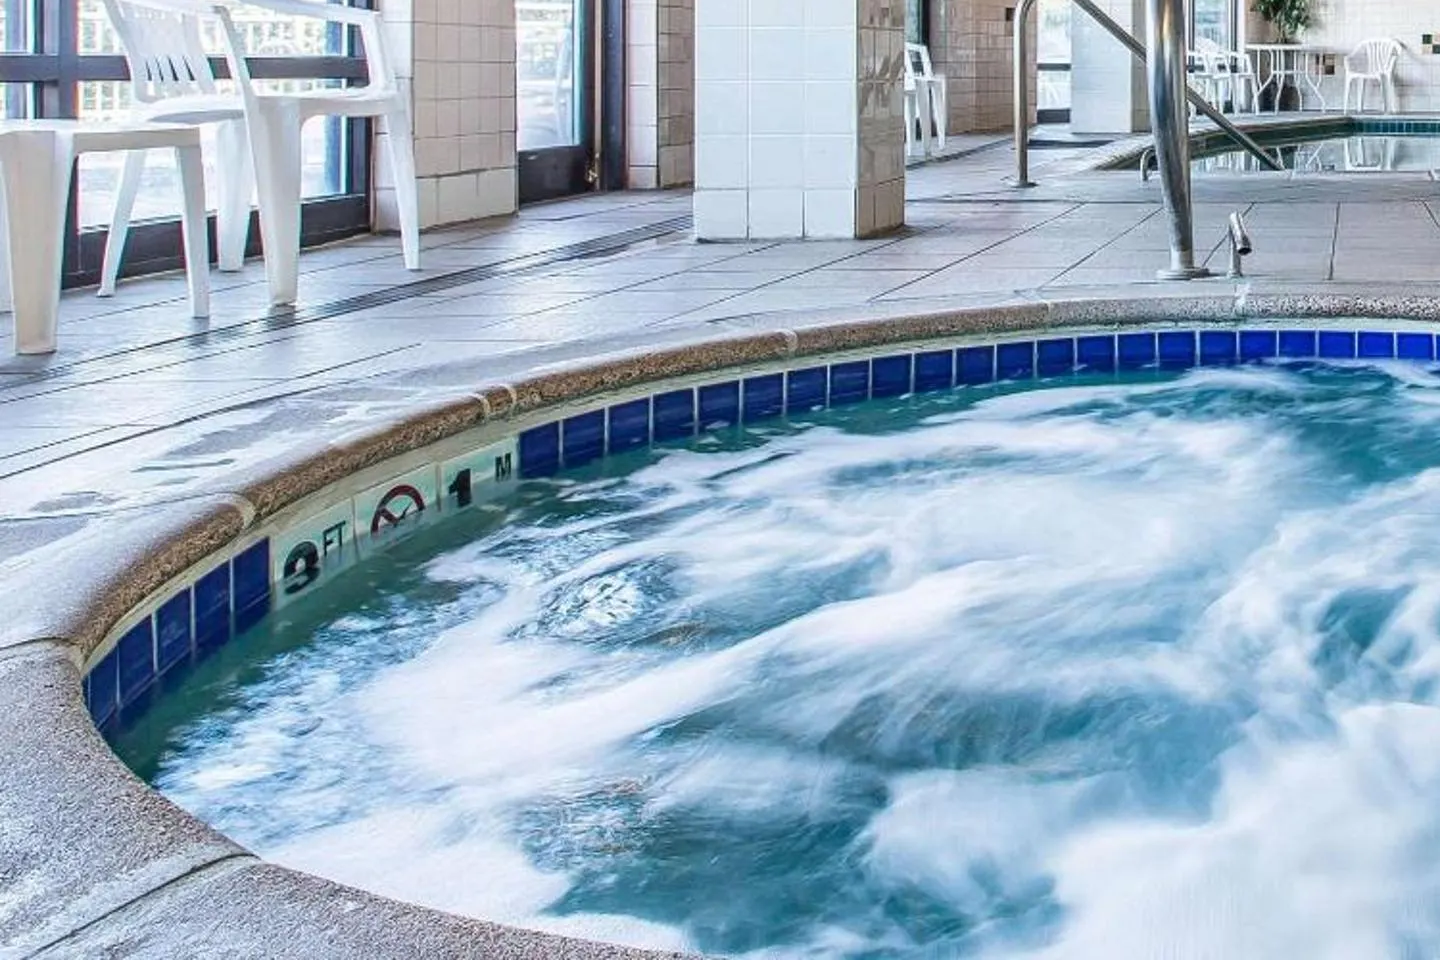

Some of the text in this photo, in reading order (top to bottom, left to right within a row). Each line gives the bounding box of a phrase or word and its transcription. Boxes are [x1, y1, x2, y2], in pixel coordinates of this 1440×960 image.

[448, 452, 511, 508] 1 M
[322, 520, 346, 557] FT
